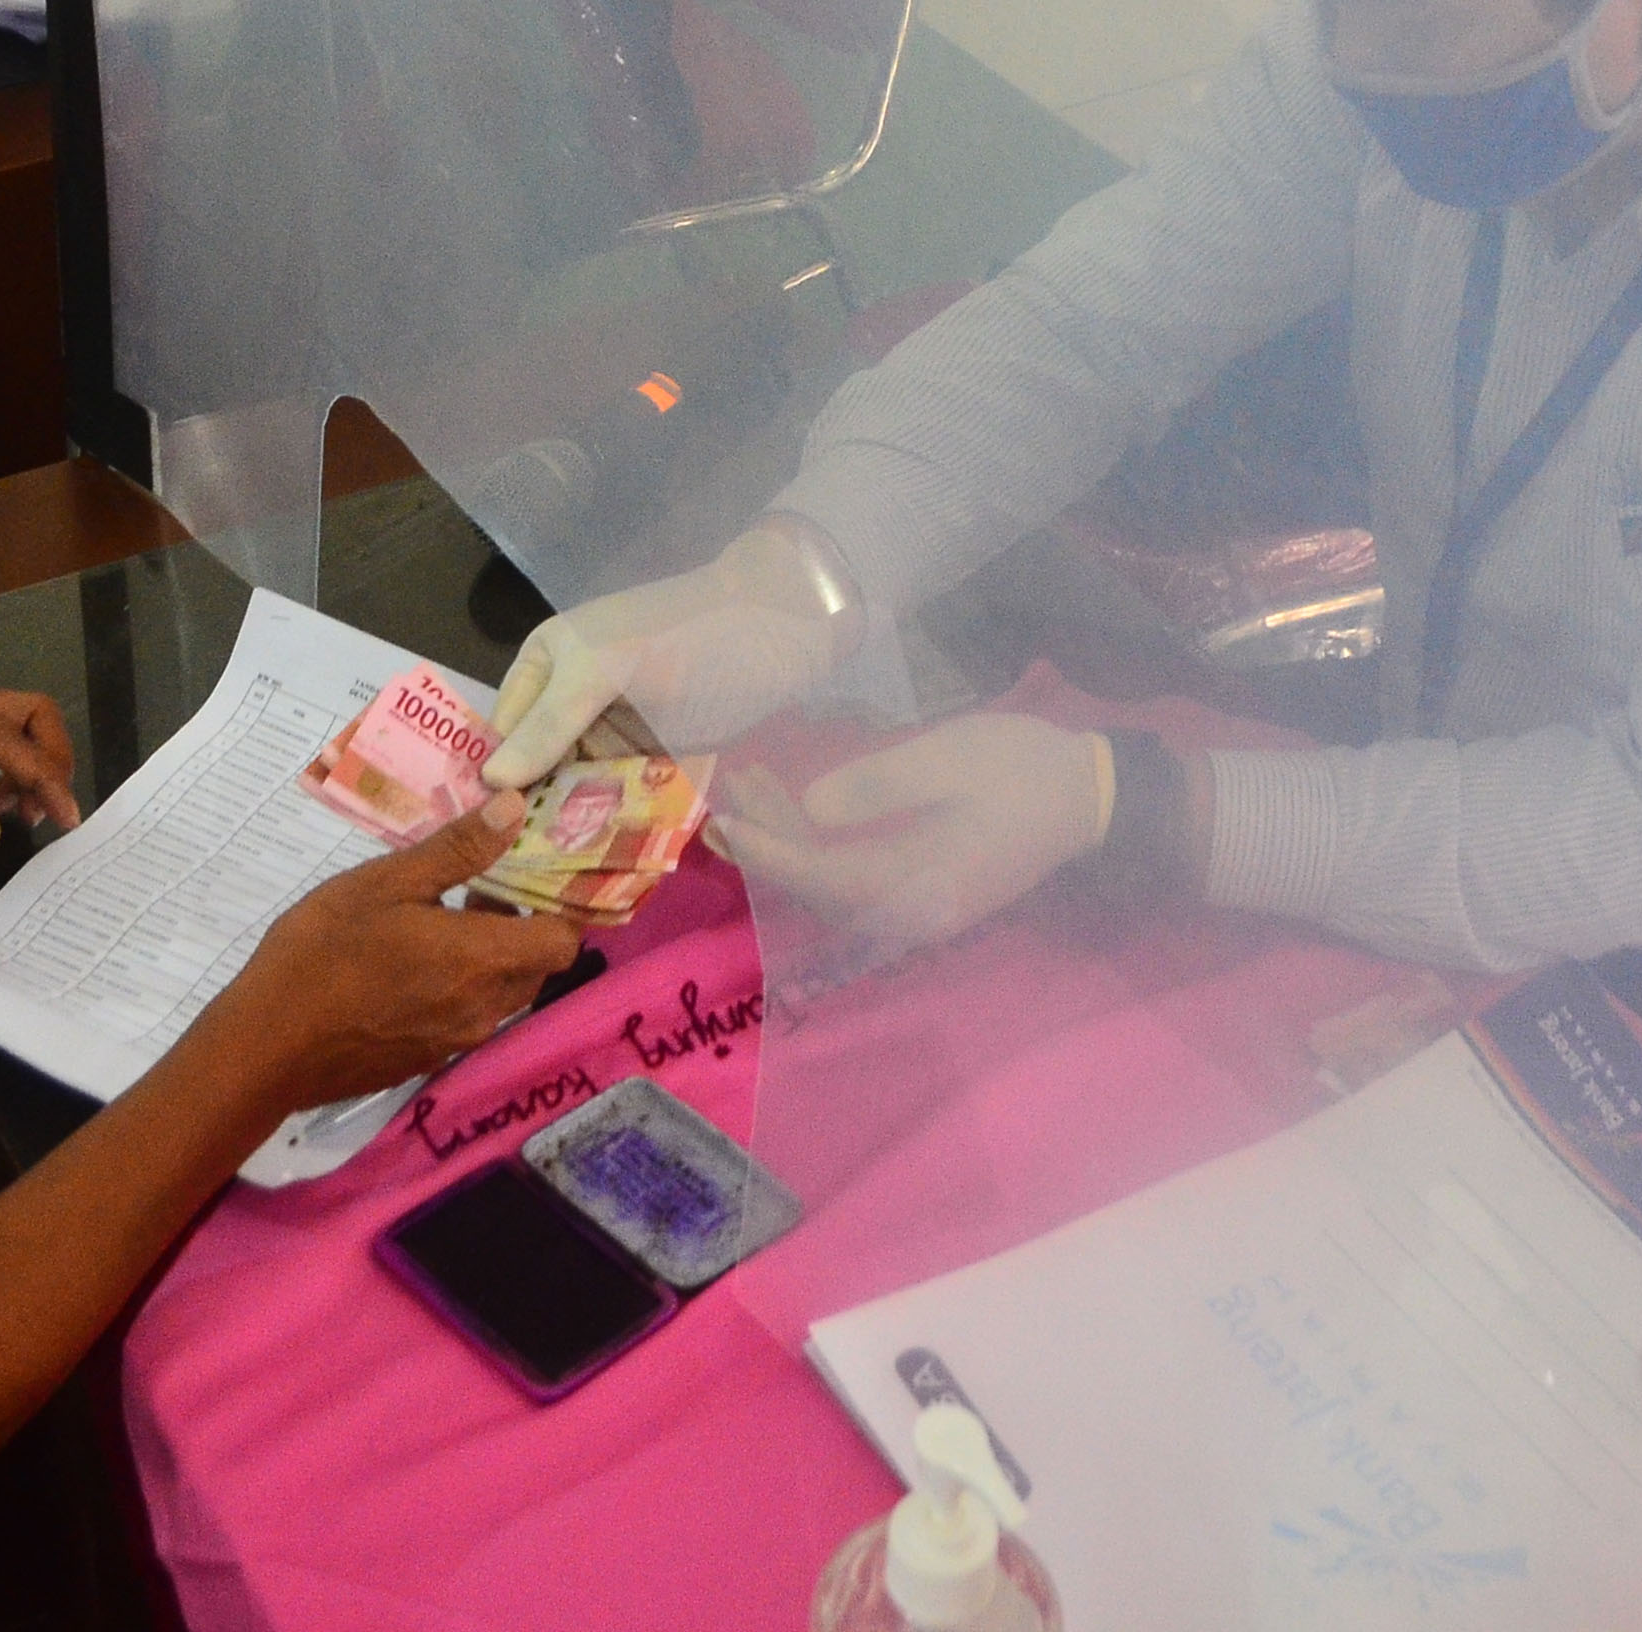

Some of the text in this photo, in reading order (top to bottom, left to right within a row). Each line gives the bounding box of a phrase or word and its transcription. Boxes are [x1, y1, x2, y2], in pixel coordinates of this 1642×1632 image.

[392, 686, 487, 762] 100000
[1201, 1280, 1444, 1547] Bank Jateng
